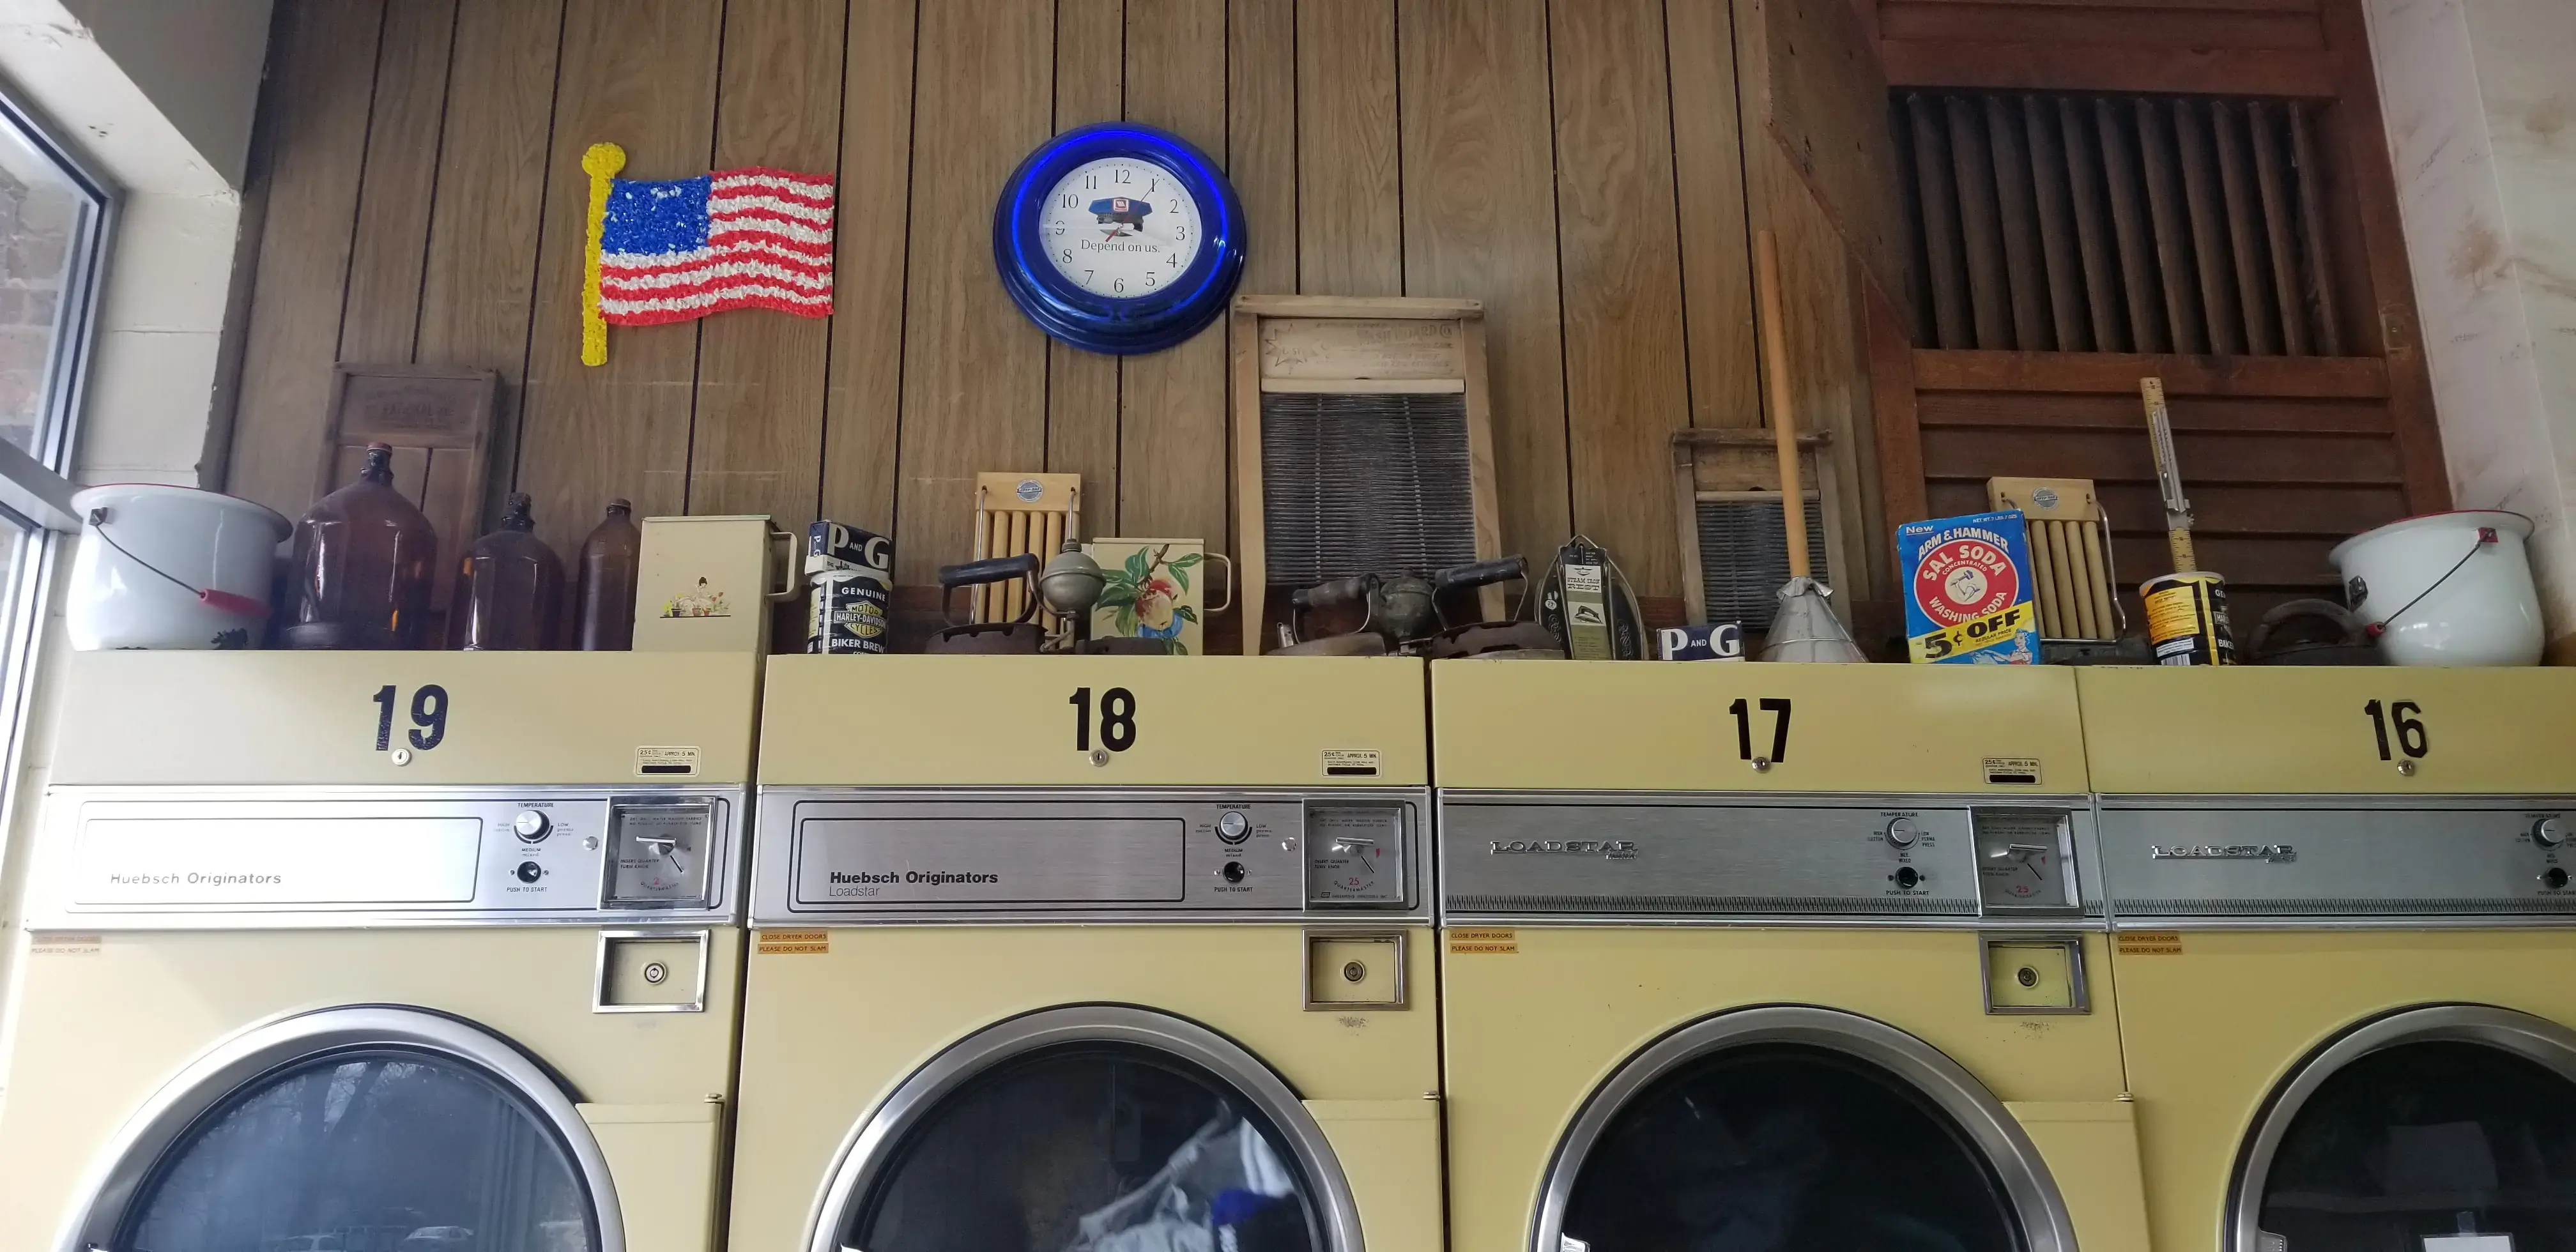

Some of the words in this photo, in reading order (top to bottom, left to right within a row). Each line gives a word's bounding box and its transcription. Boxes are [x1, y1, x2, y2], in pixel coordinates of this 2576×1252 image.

[1085, 175, 1097, 190] 11
[1114, 169, 1131, 184] 12
[1062, 194, 1078, 209] 10
[1170, 199, 1179, 214] 2
[1055, 220, 1065, 235] 9
[1176, 226, 1185, 241] 3
[1081, 240, 1124, 253] Depend
[1128, 243, 1142, 252] on
[1145, 245, 1161, 253] us.
[1062, 249, 1073, 264] 8
[1166, 253, 1177, 268] 4
[1084, 270, 1094, 284] 7
[1146, 271, 1155, 287] 5
[1114, 278, 1124, 293] 6
[1906, 525, 1934, 533] New
[827, 523, 849, 556] P
[850, 542, 862, 551] AND
[864, 537, 890, 569] G
[1918, 533, 1942, 561] ARM
[1943, 528, 1953, 541] &
[1953, 527, 2009, 553] HAMMER
[1923, 551, 1953, 581] SAL
[1959, 545, 2007, 576] SODA
[1942, 560, 1987, 576] CONCENTRATED
[841, 587, 885, 602] GENUINE
[852, 604, 878, 615] MOTOR
[1929, 596, 1979, 623] WASHING
[1981, 592, 2007, 616] SODA
[850, 623, 878, 636] CYCLES
[1966, 609, 2020, 638] OFF
[831, 639, 861, 648] BIKER
[863, 641, 885, 653] BREW
[1661, 629, 1689, 660] P
[1690, 639, 1707, 647] AND
[1709, 624, 1740, 657] G
[373, 684, 448, 751] 19
[1069, 687, 1137, 752] 18
[1729, 698, 1791, 763] 17
[2365, 699, 2428, 760] 16
[1491, 840, 1636, 855] LOADSTAR
[2151, 844, 2295, 859] LOADSTAR
[111, 873, 180, 885] Huebsch
[188, 873, 282, 887] Originators
[830, 871, 899, 884] Huebsch
[906, 871, 998, 886] Originators
[1333, 880, 1374, 892] QUARTERMASTER
[1349, 877, 1360, 885] 25
[829, 886, 881, 897] Loadstar
